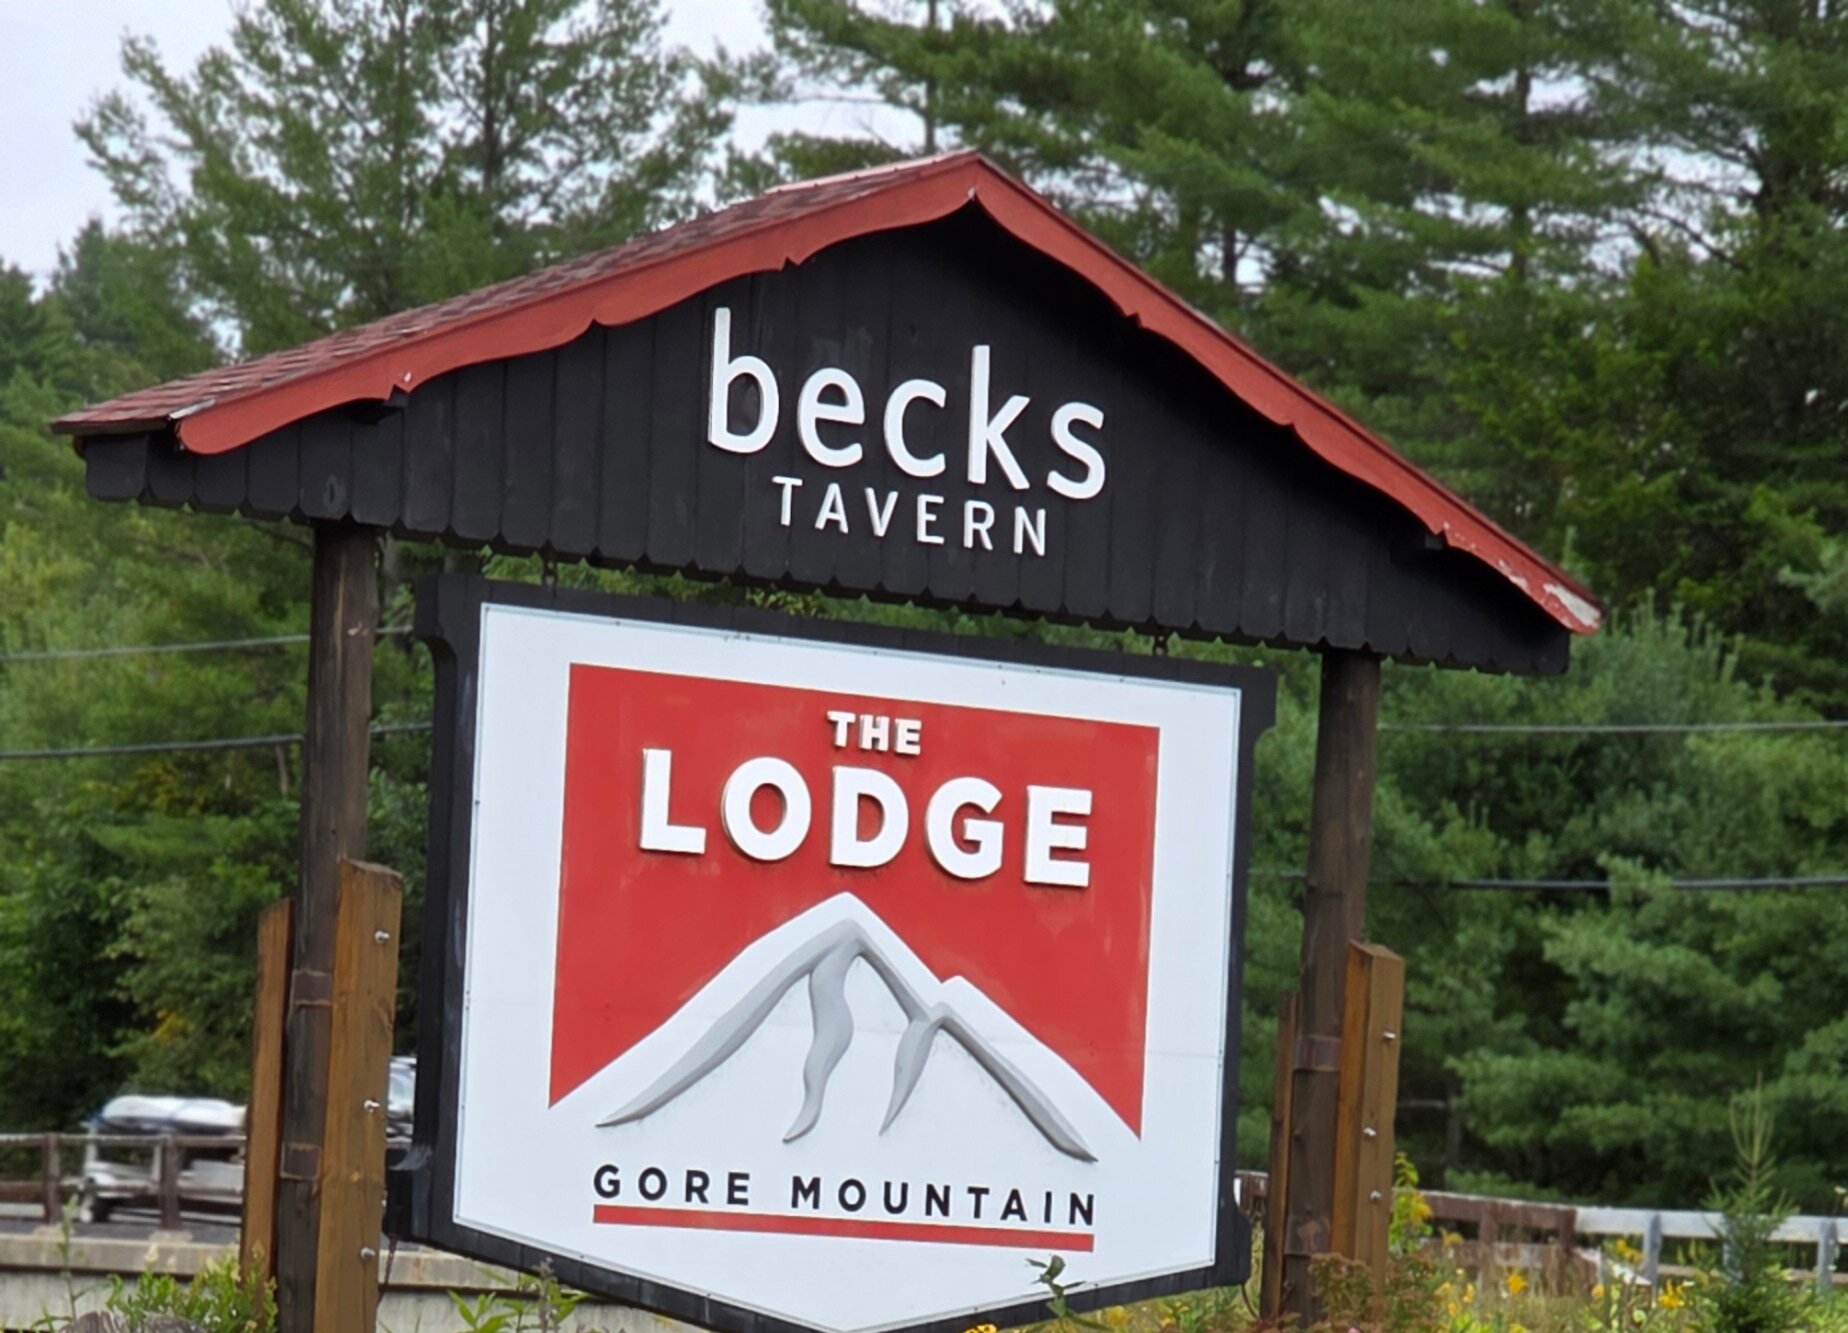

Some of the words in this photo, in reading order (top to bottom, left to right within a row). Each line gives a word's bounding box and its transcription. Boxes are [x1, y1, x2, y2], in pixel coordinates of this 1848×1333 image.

[708, 306, 1107, 500] becks
[772, 475, 1047, 557] TAVERN
[826, 710, 923, 755] THE
[639, 748, 1093, 887] LODGE
[593, 1164, 750, 1206] GORE
[791, 1175, 1095, 1226] MOUNTAIN
